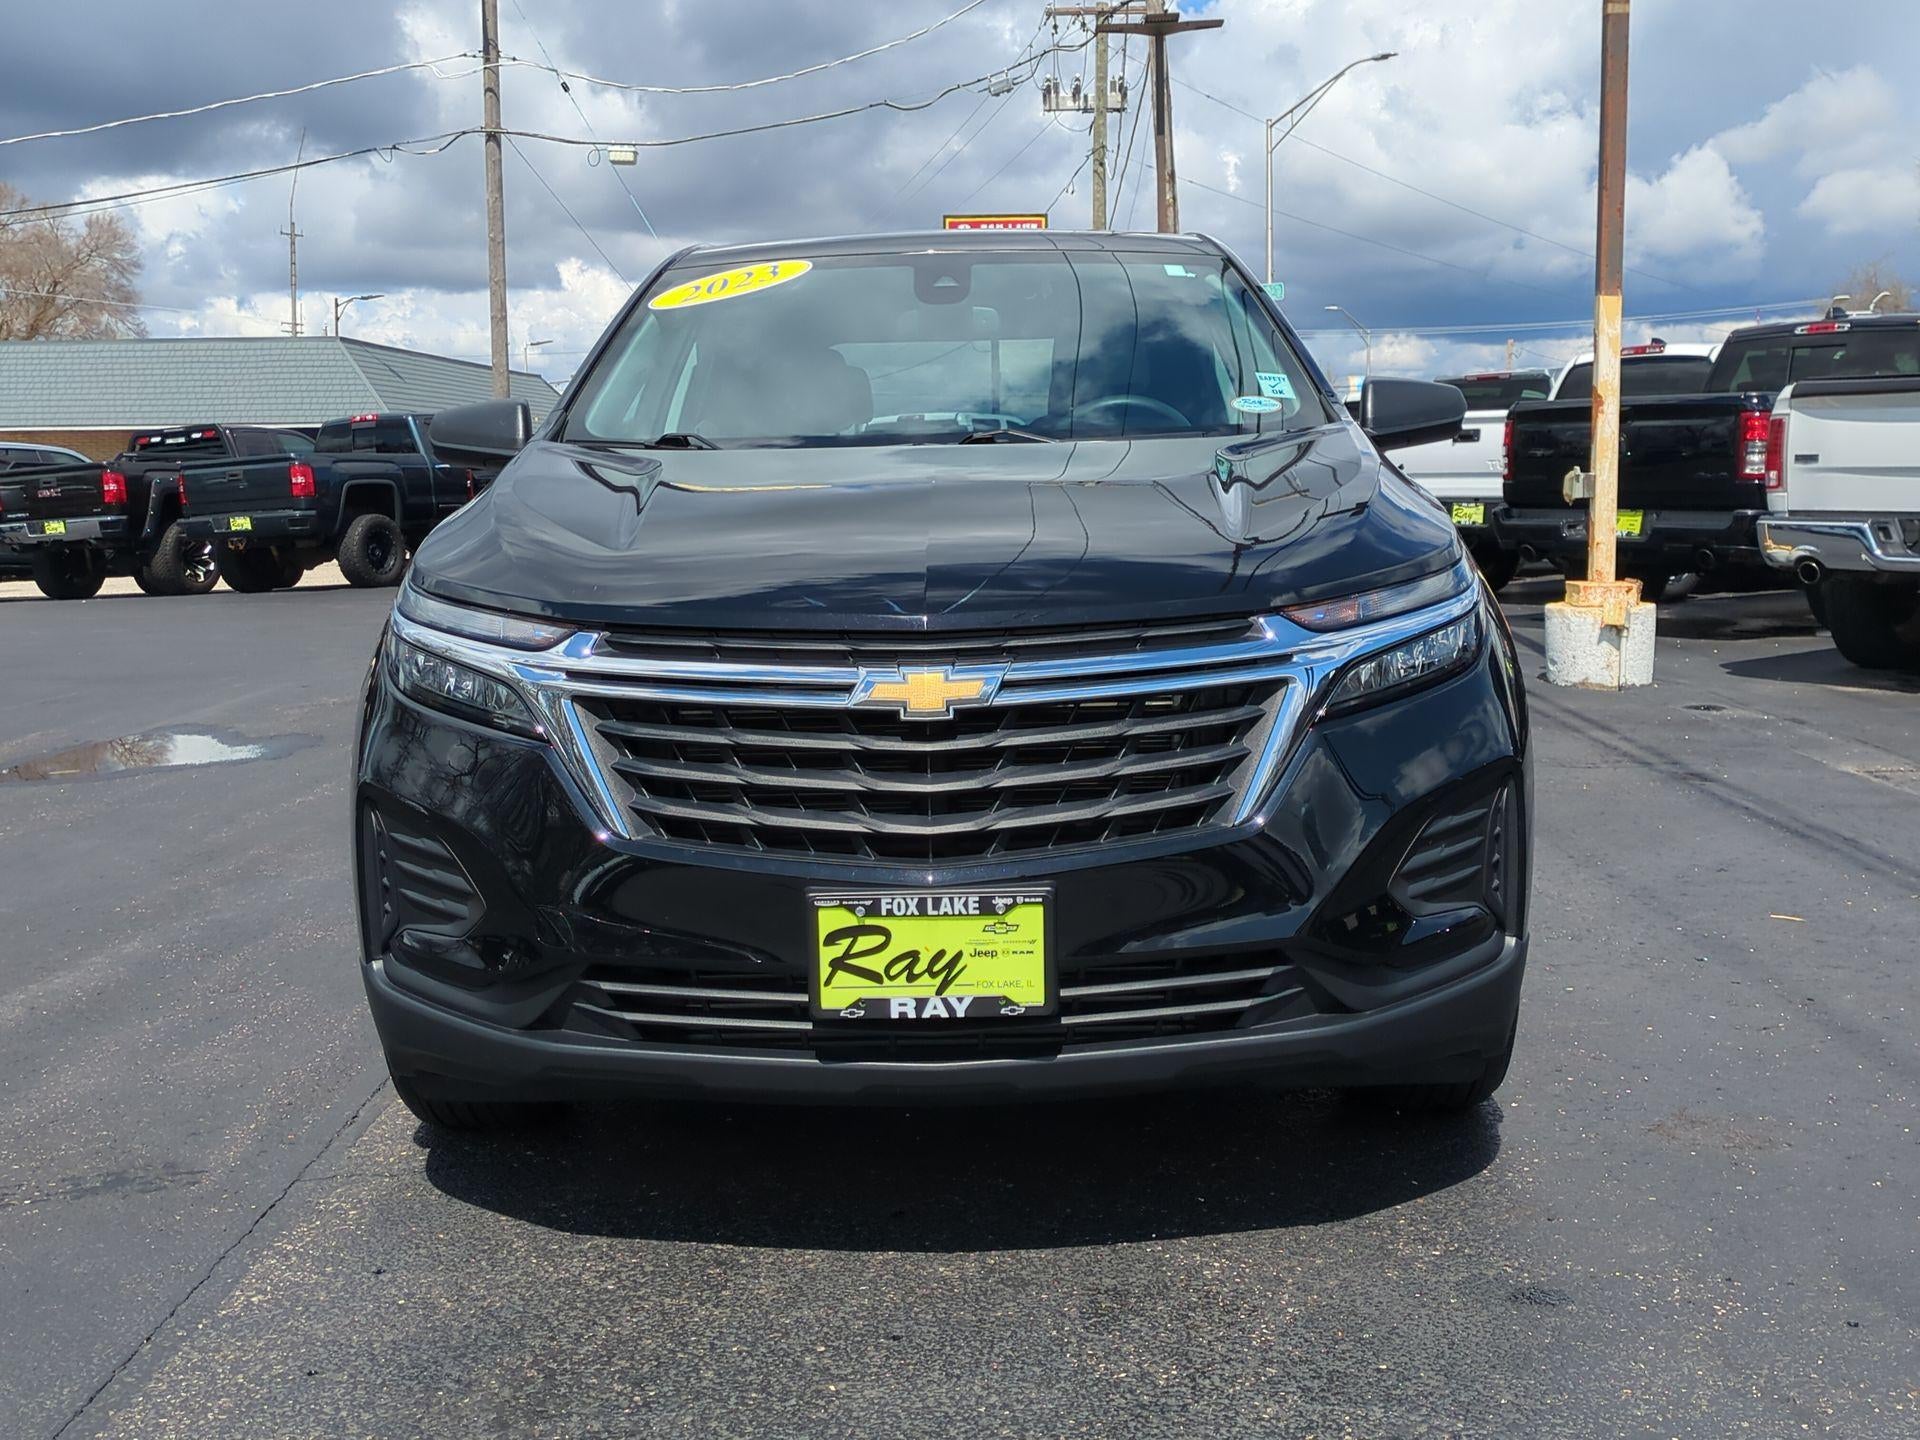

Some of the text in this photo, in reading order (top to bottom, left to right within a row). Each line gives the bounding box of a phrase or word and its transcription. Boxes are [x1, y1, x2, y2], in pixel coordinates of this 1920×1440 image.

[681, 265, 778, 302] 2023
[881, 896, 980, 916] FOX LAKE
[992, 896, 1014, 905] Jeep
[822, 924, 968, 996] Ray
[969, 948, 998, 959] Jeep
[976, 981, 994, 989] FOX
[1026, 980, 1035, 988] IL
[890, 997, 975, 1018] RAY
